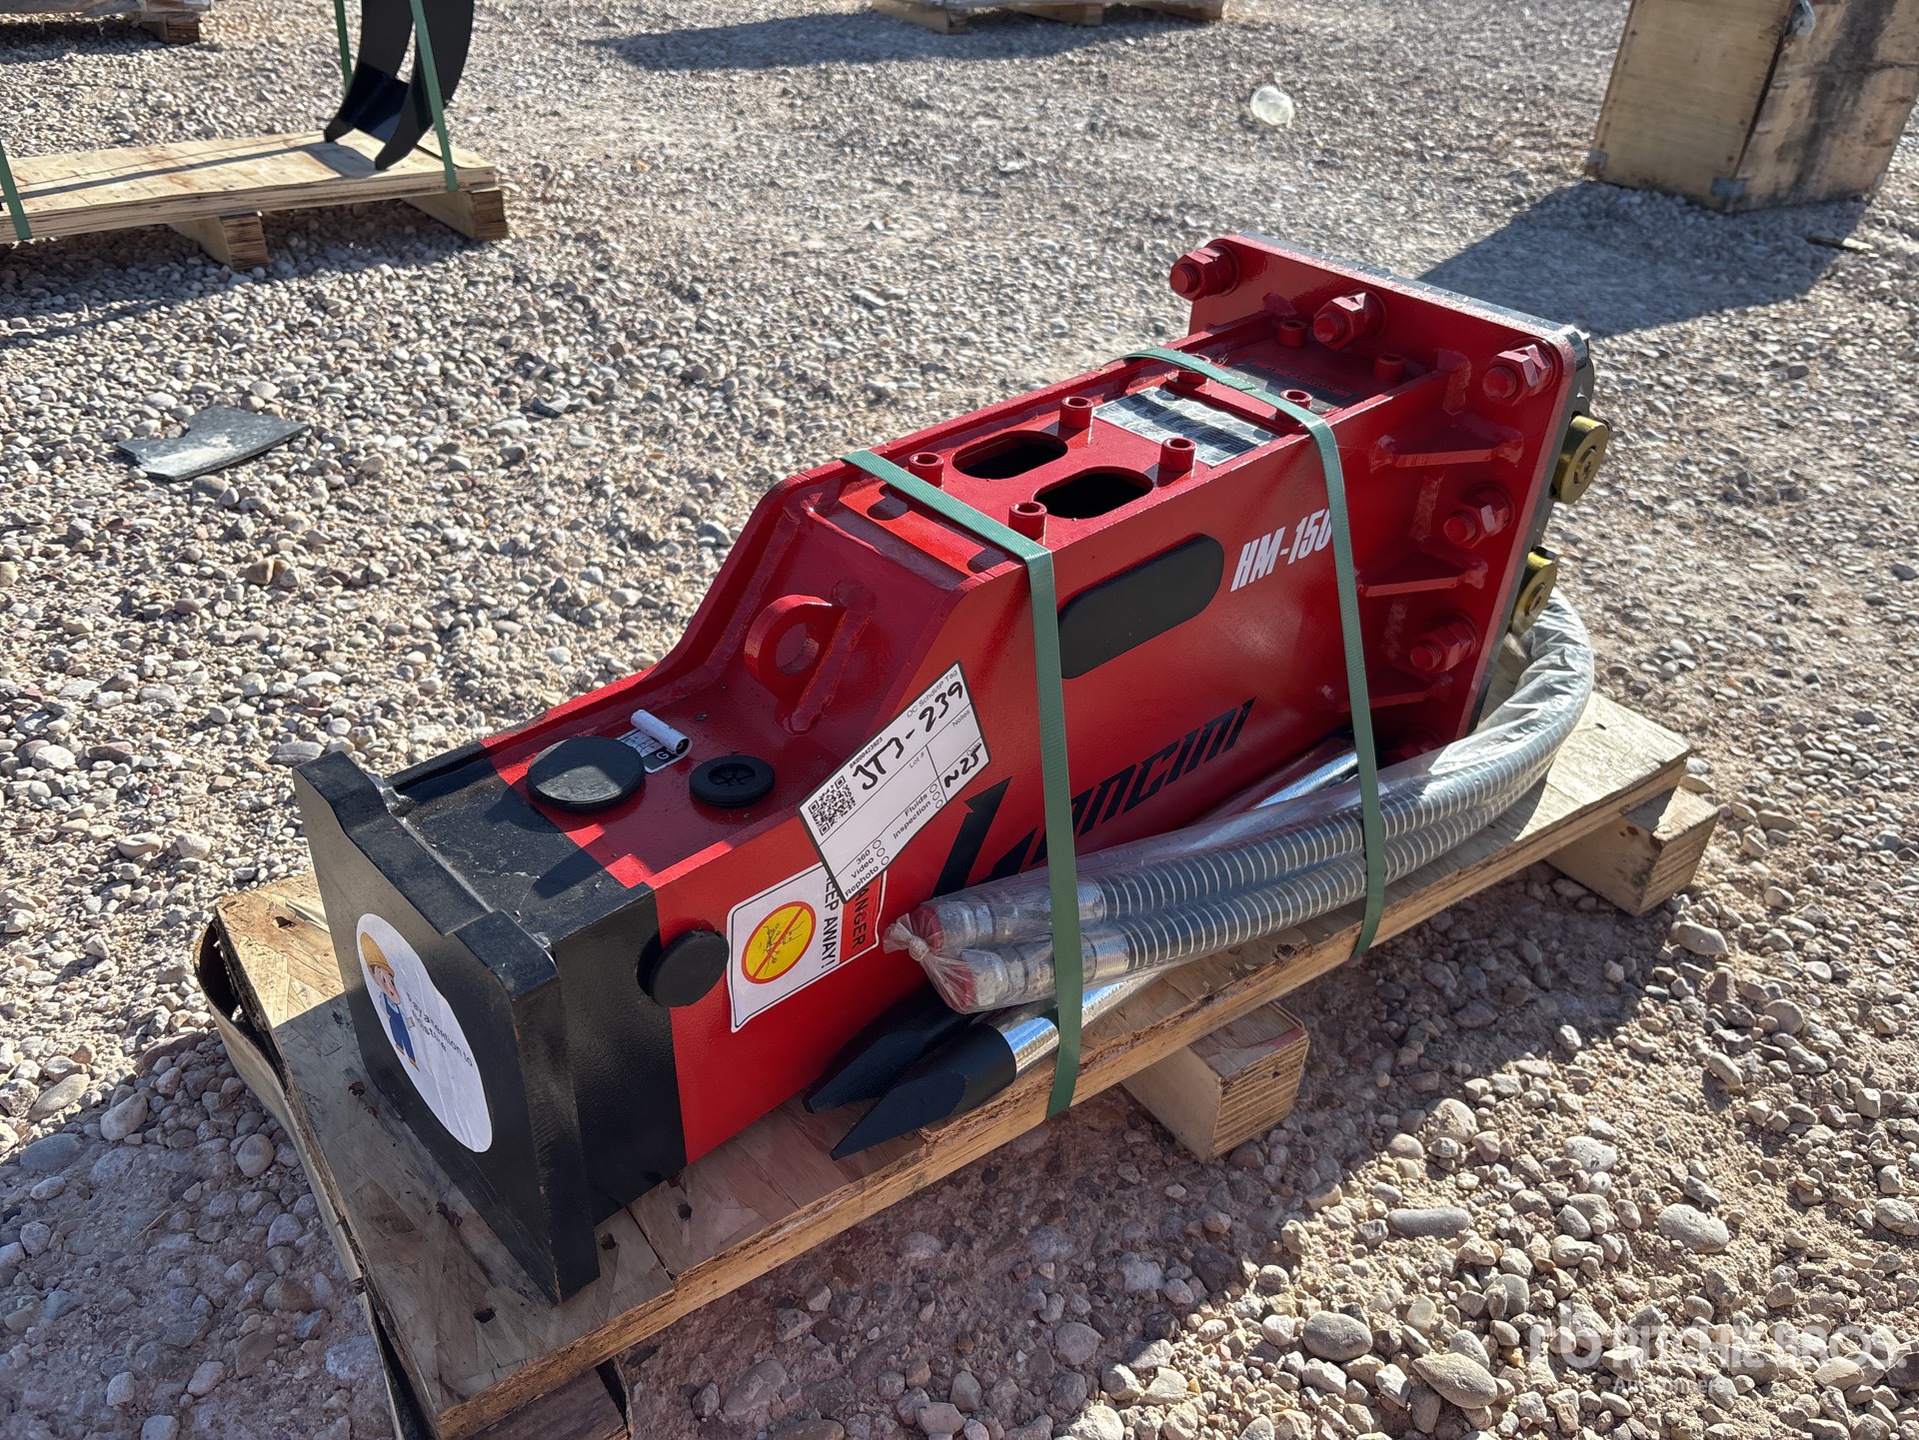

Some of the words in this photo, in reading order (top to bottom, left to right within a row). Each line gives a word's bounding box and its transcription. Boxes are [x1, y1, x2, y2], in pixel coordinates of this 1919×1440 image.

[944, 669, 958, 682] Tag
[952, 709, 971, 728] Notes
[908, 756, 920, 769] Lot
[904, 793, 928, 817] Fluids
[893, 800, 931, 840] Inspection
[850, 857, 875, 879] Video
[855, 849, 871, 865] 360
[844, 865, 879, 897] Rephoto
[825, 877, 840, 912] EEP
[852, 887, 870, 949] ANGER
[821, 916, 839, 969] AWAY!
